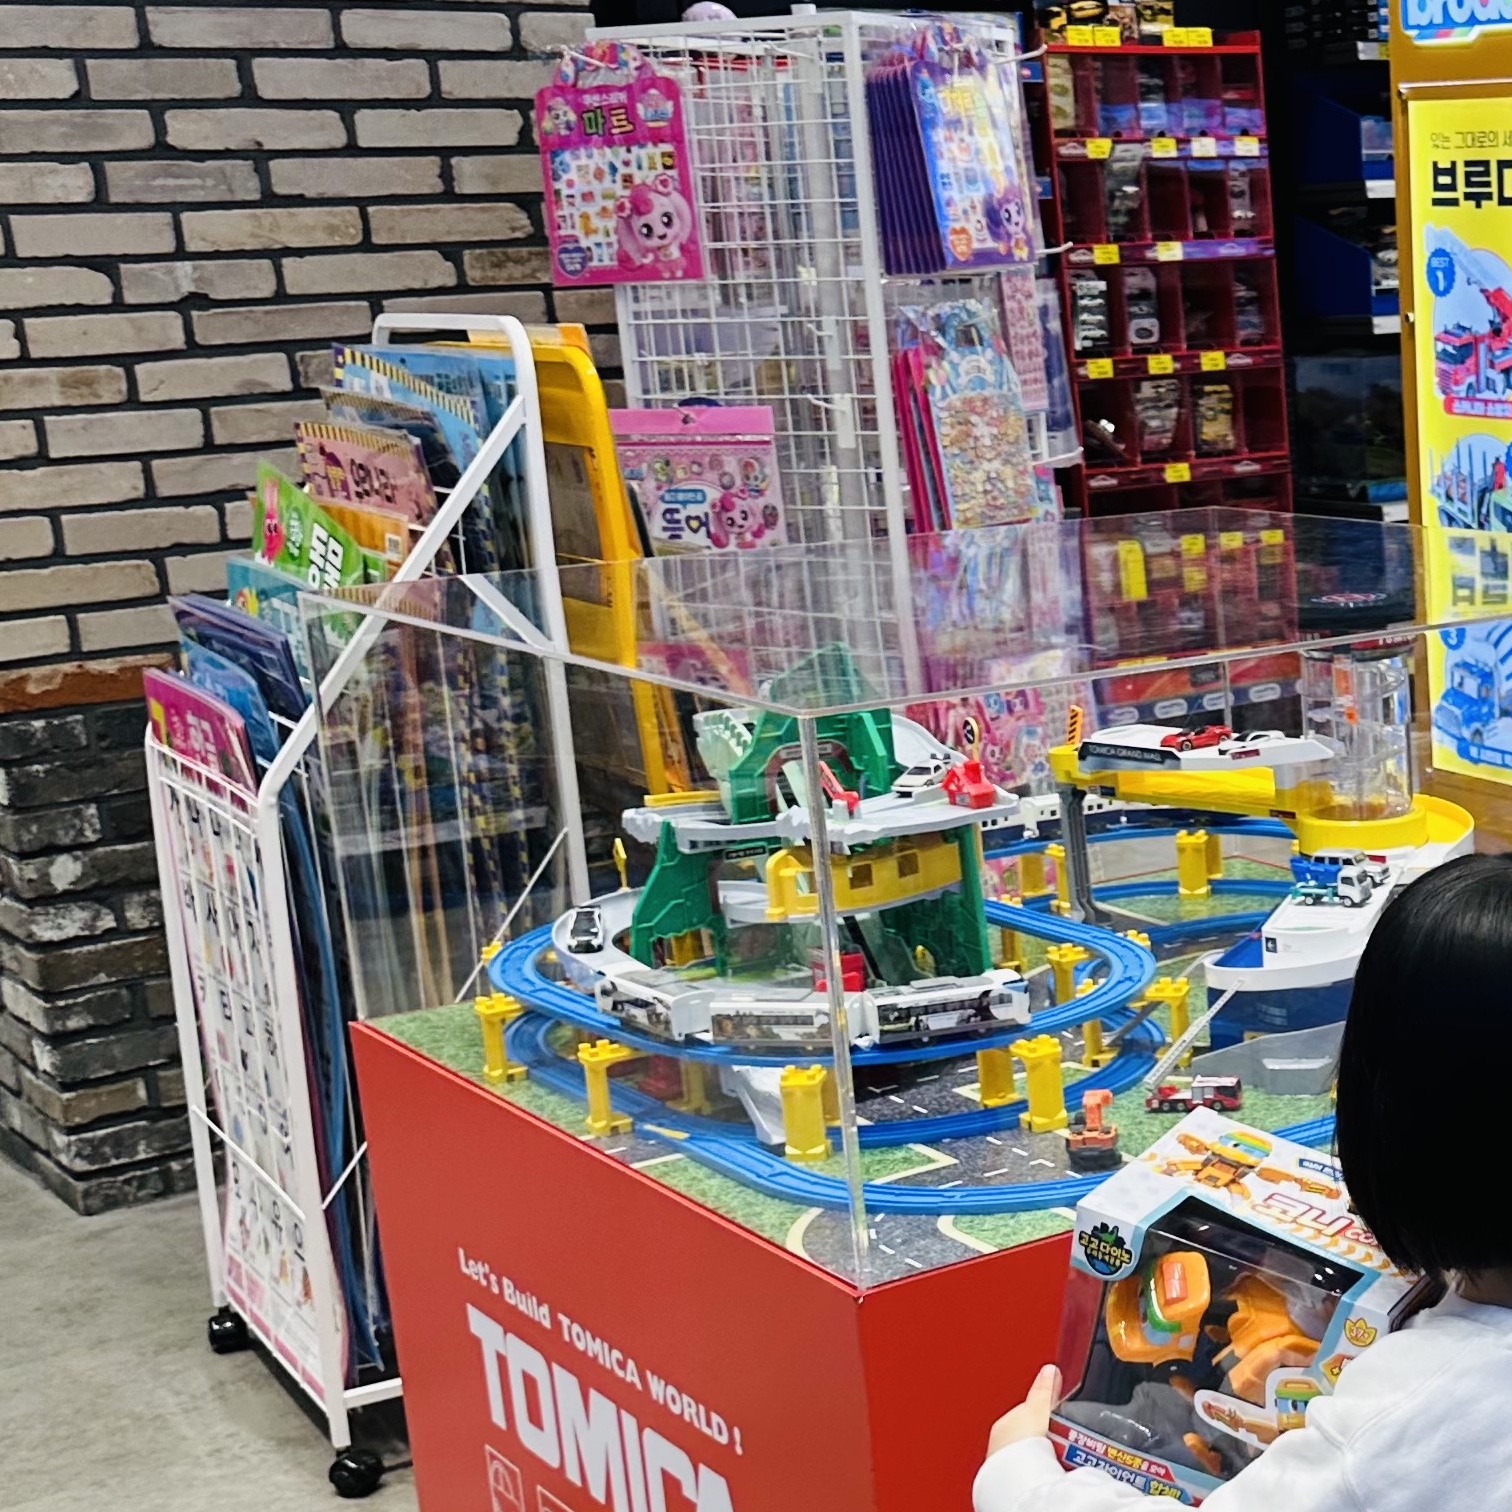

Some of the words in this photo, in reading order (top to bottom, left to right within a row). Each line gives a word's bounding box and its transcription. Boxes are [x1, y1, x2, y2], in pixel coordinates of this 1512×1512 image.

[1431, 257, 1449, 268] BEST
[1436, 270, 1445, 291] 1
[1079, 1231, 1132, 1264] 고고다이노
[458, 1247, 500, 1295] Let's
[502, 1276, 552, 1330] Build
[558, 1312, 642, 1392] TOMICA
[646, 1369, 730, 1446] WORLD
